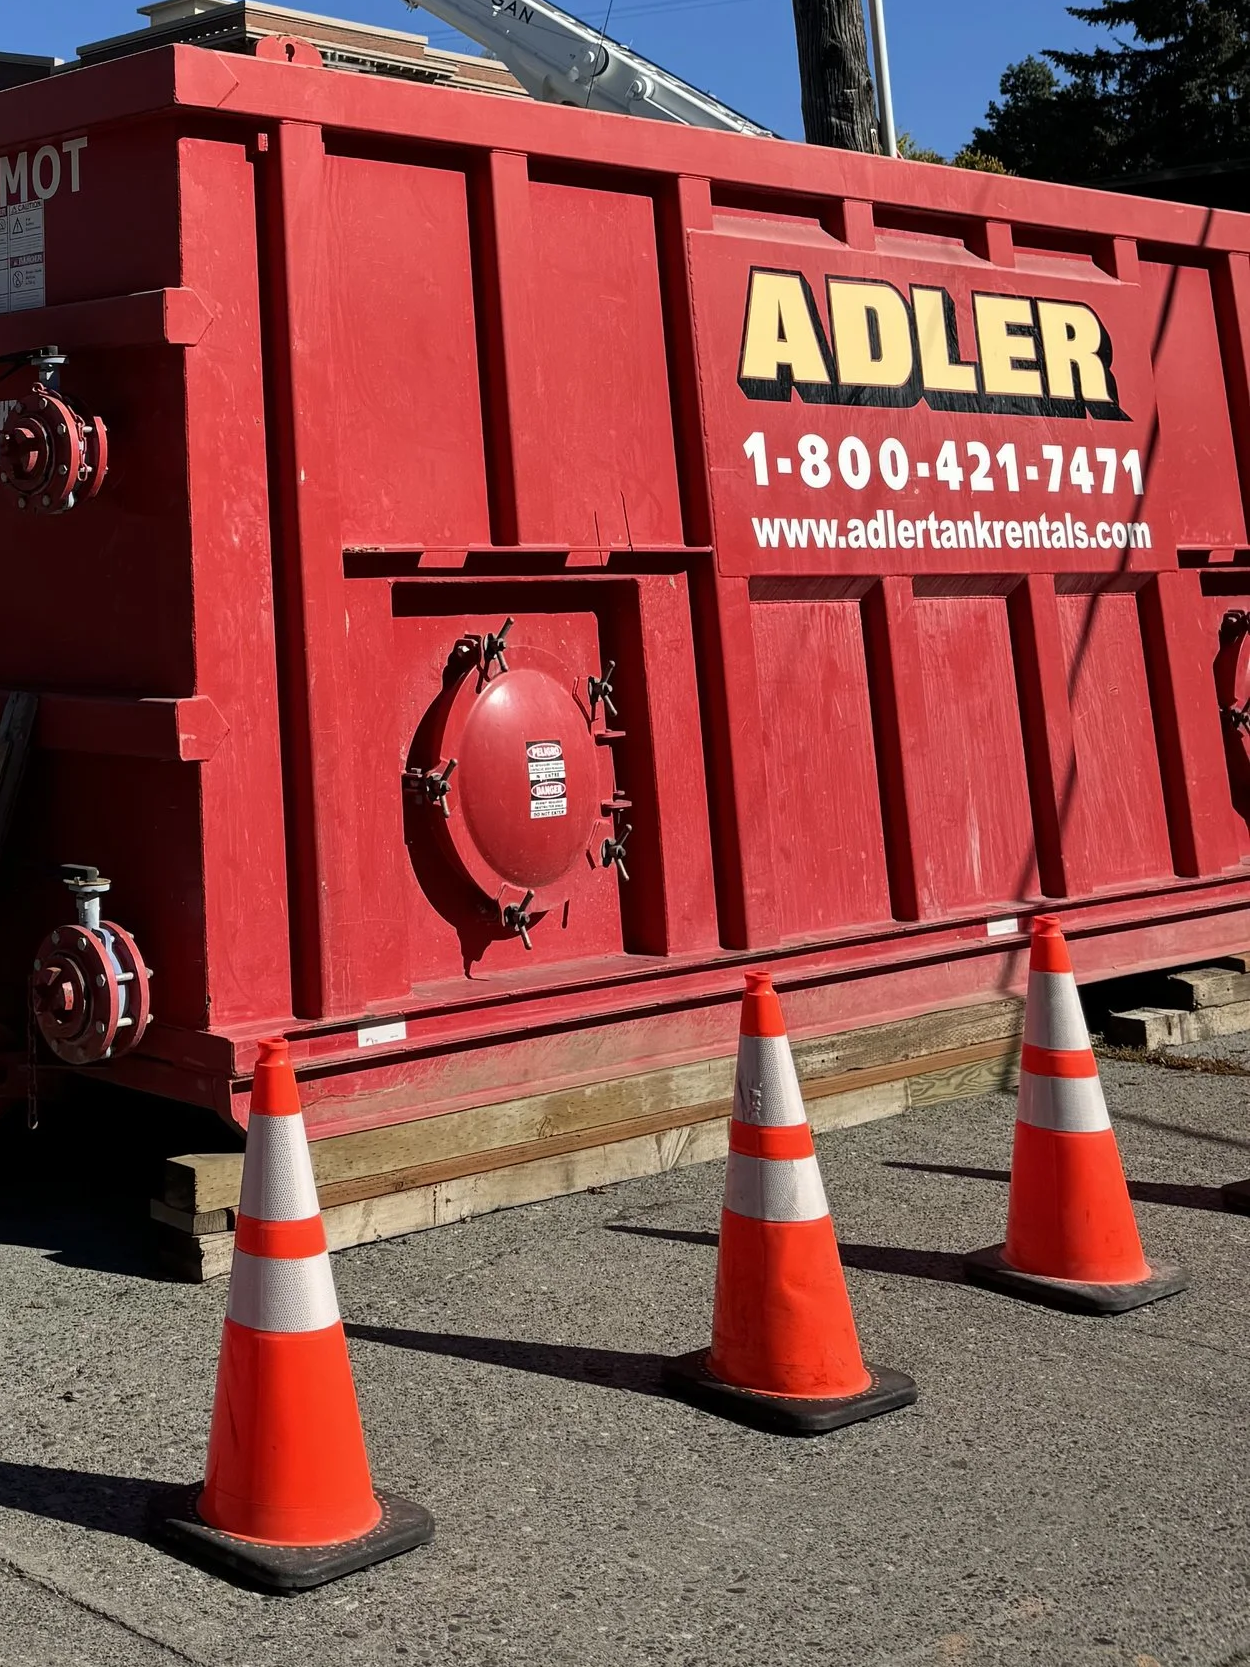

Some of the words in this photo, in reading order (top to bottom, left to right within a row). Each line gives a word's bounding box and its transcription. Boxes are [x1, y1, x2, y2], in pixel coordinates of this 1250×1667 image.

[737, 266, 1134, 422] ADLER
[743, 431, 1145, 496] 1-800-421-7471
[751, 509, 1153, 550] www.adlertankrentals.com
